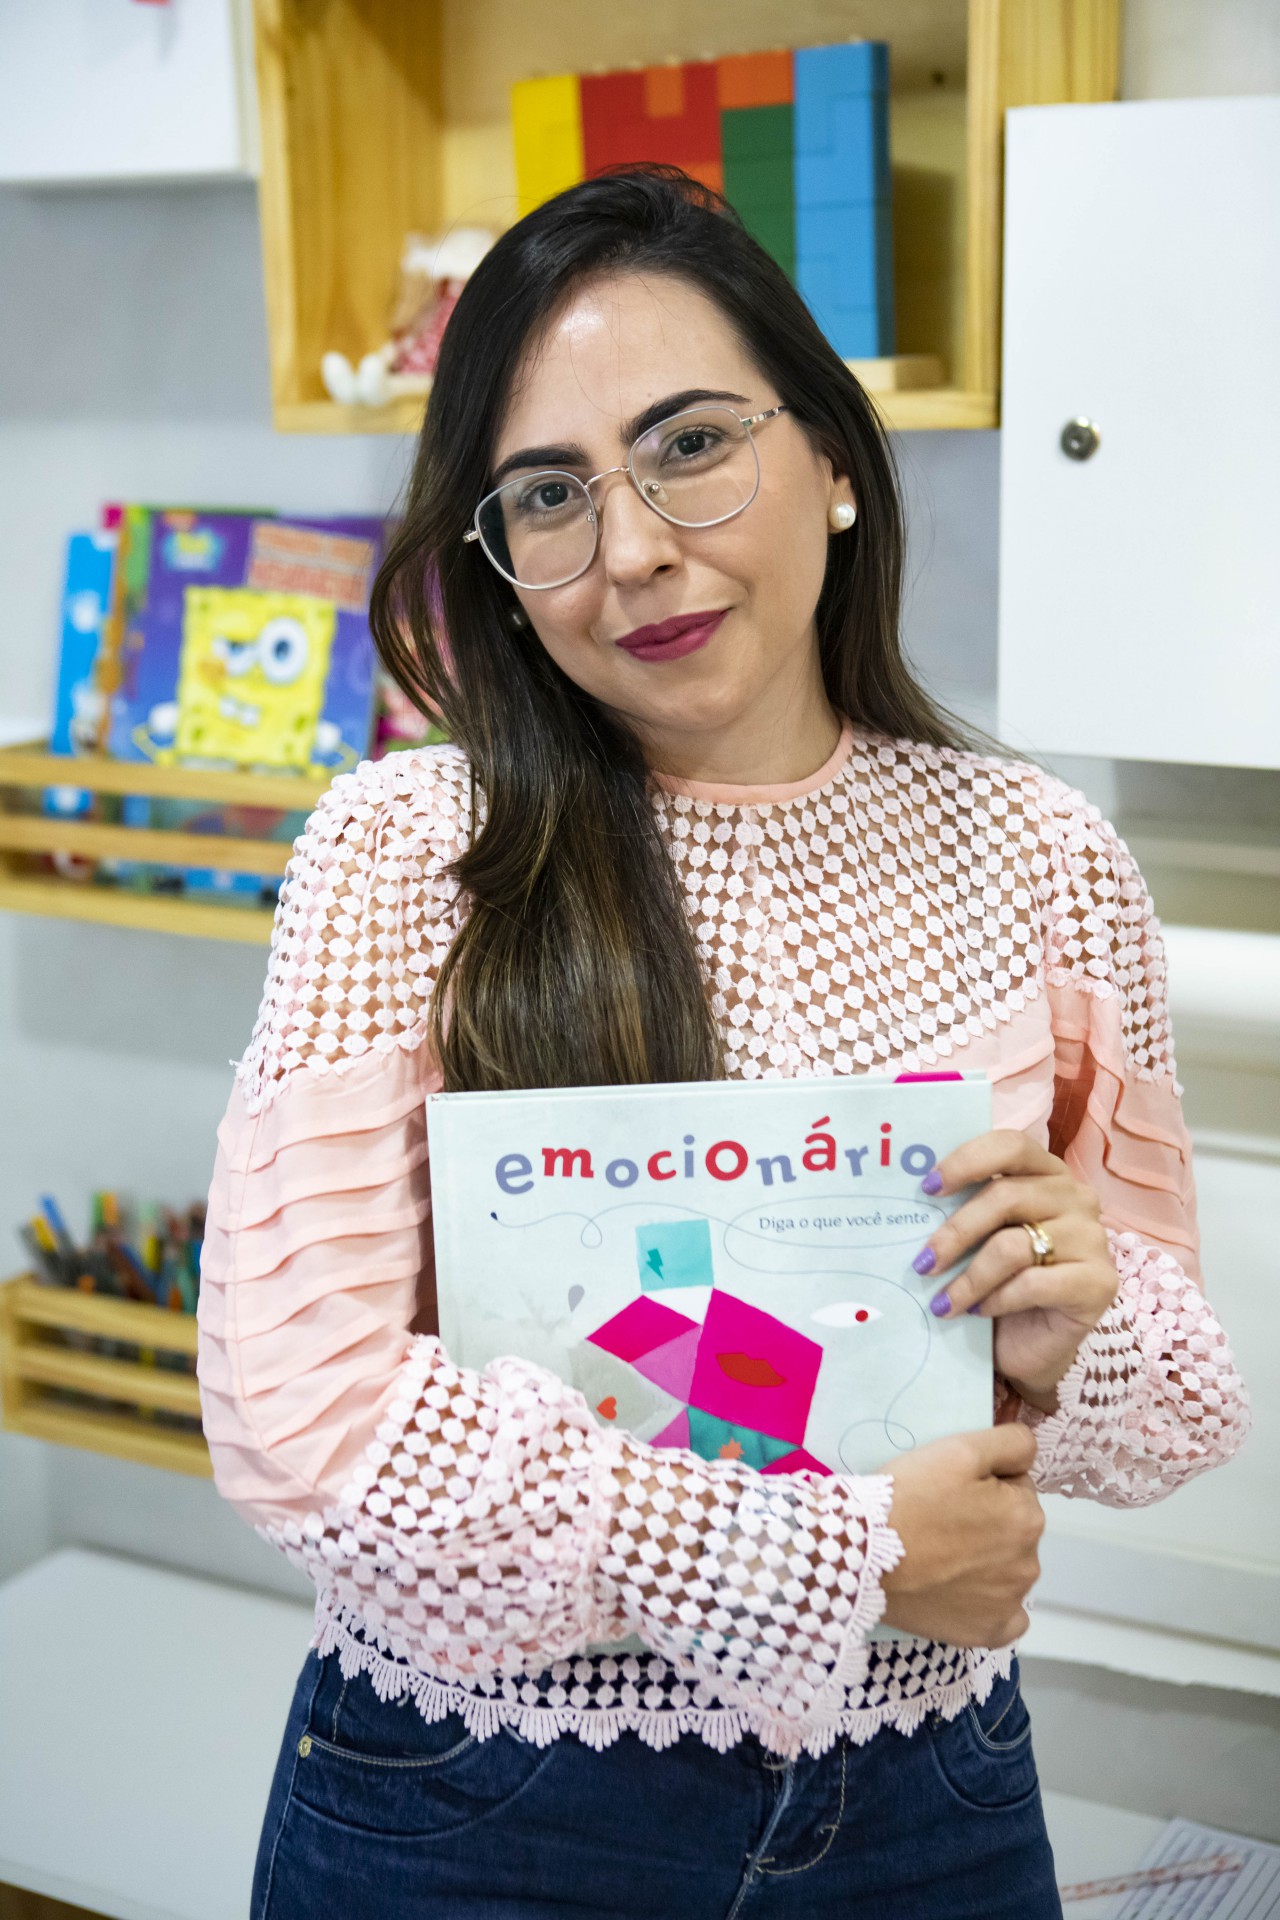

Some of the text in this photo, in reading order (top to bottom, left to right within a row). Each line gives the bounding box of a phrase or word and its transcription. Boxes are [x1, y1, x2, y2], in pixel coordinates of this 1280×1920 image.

[495, 1115, 937, 1194] emocionário
[759, 1211, 931, 1233] Diga o que você sente
